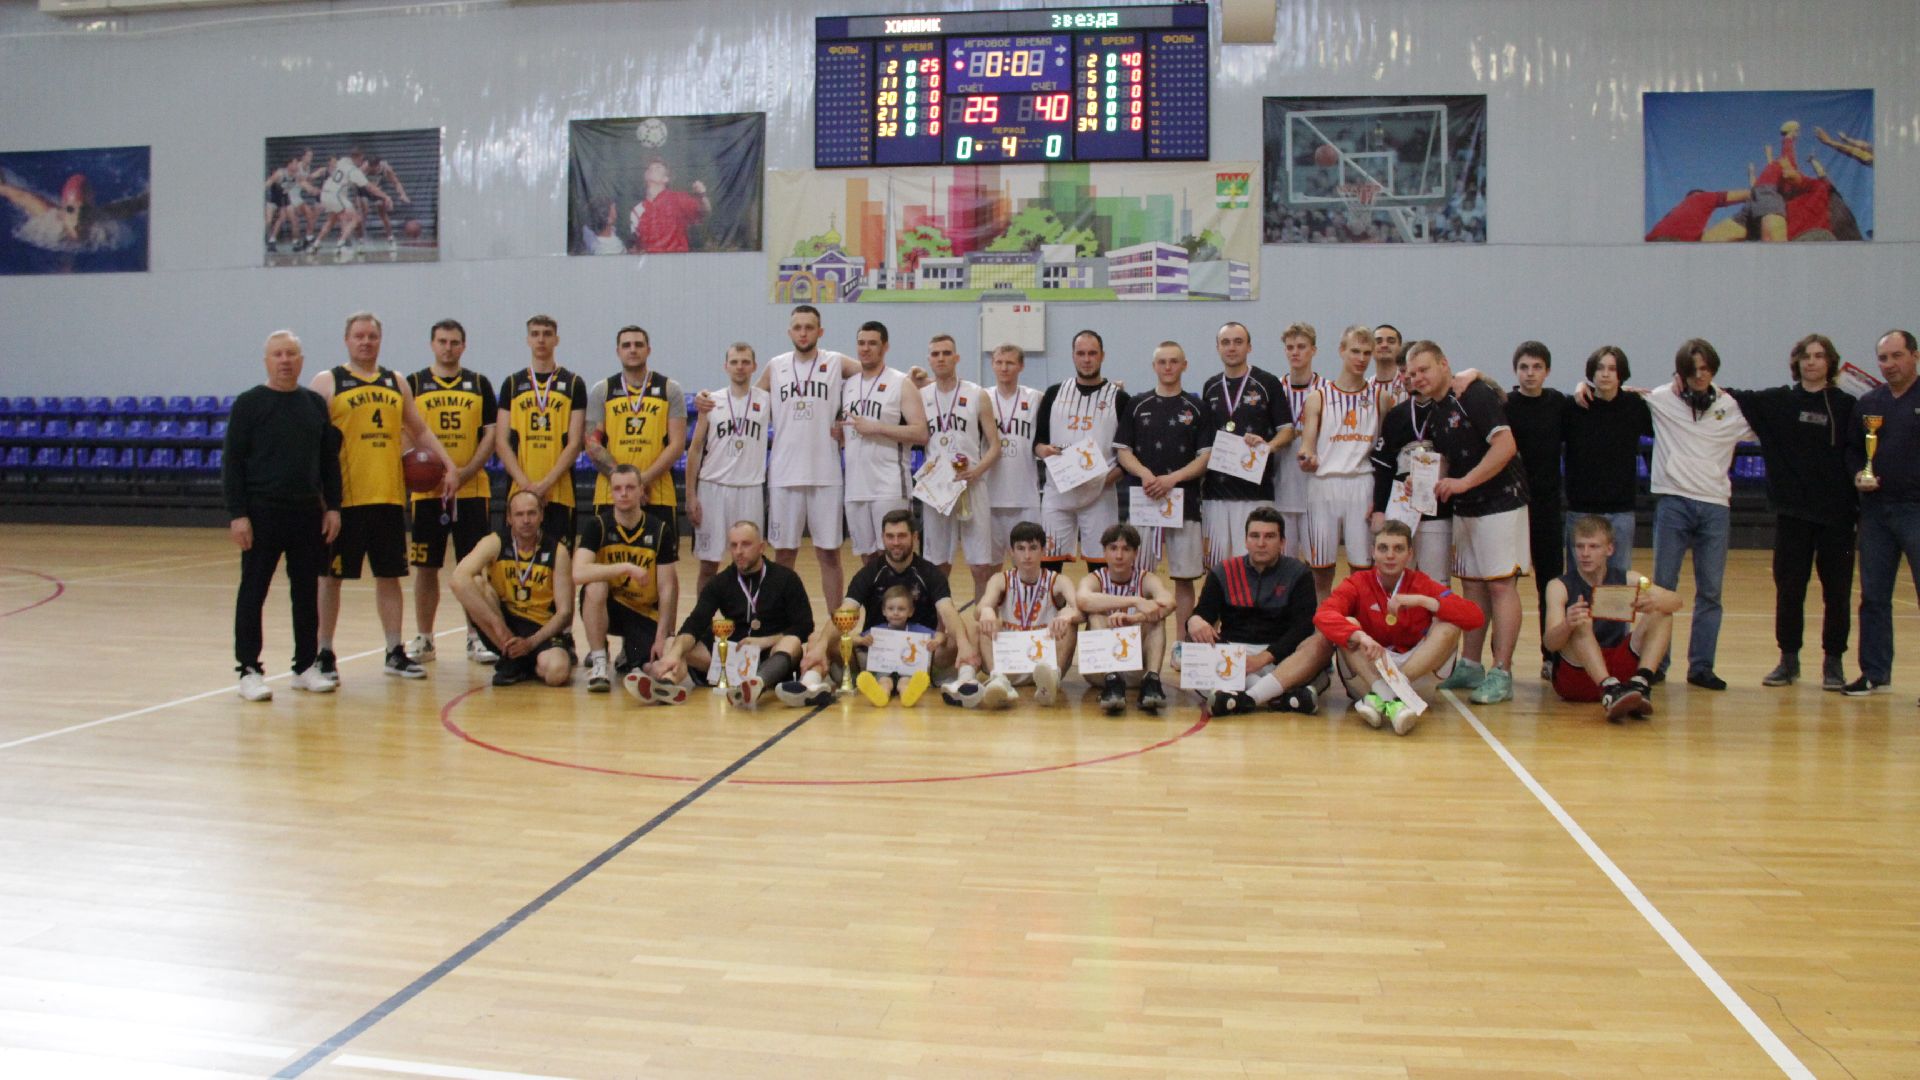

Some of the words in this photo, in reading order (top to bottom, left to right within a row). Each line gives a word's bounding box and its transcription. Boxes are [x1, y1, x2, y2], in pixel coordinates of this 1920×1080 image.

[964, 38, 1011, 48] ИГРОВОЕ
[1016, 37, 1053, 46] ВРЕМЯ
[1102, 36, 1135, 45] ВРЕМЯ
[1162, 34, 1195, 43] ФОЛЫ
[902, 42, 934, 52] ВРЕМЯ
[887, 60, 898, 74] 2
[906, 60, 917, 74] 0
[920, 58, 940, 73] 25
[1087, 53, 1098, 67] 2
[1106, 53, 1117, 67] 0
[1121, 52, 1142, 66] 40
[882, 76, 898, 89] 11
[906, 75, 917, 89] 0
[930, 74, 940, 88] 0
[1087, 69, 1098, 83] 5
[1106, 69, 1117, 83] 0
[1131, 68, 1142, 82] 0
[877, 91, 898, 106] 20
[906, 91, 917, 105] 0
[930, 89, 940, 104] 0
[1087, 86, 1098, 100] 6
[1106, 85, 1117, 99] 0
[1131, 84, 1142, 98] 0
[877, 107, 898, 121] 21
[906, 106, 917, 121] 0
[930, 105, 940, 119] 0
[964, 96, 998, 123] 25
[1035, 94, 1069, 121] 40
[1106, 101, 1117, 115] 0
[1131, 100, 1142, 114] 0
[877, 122, 898, 137] 32
[906, 122, 917, 136] 0
[929, 121, 940, 135] 0
[1077, 117, 1098, 132] 34
[1106, 117, 1117, 131] 0
[1131, 116, 1142, 131] 0
[957, 136, 972, 159] 0
[1002, 136, 1017, 157] 4
[1046, 134, 1062, 157] 0
[348, 391, 398, 409] KHIMIK
[425, 396, 474, 411] KHIMIK
[520, 397, 563, 413] KHIK
[372, 408, 383, 429] 4
[440, 411, 461, 430] 65
[625, 416, 647, 435] 67
[1067, 415, 1094, 431] 25
[1344, 410, 1357, 430] 4
